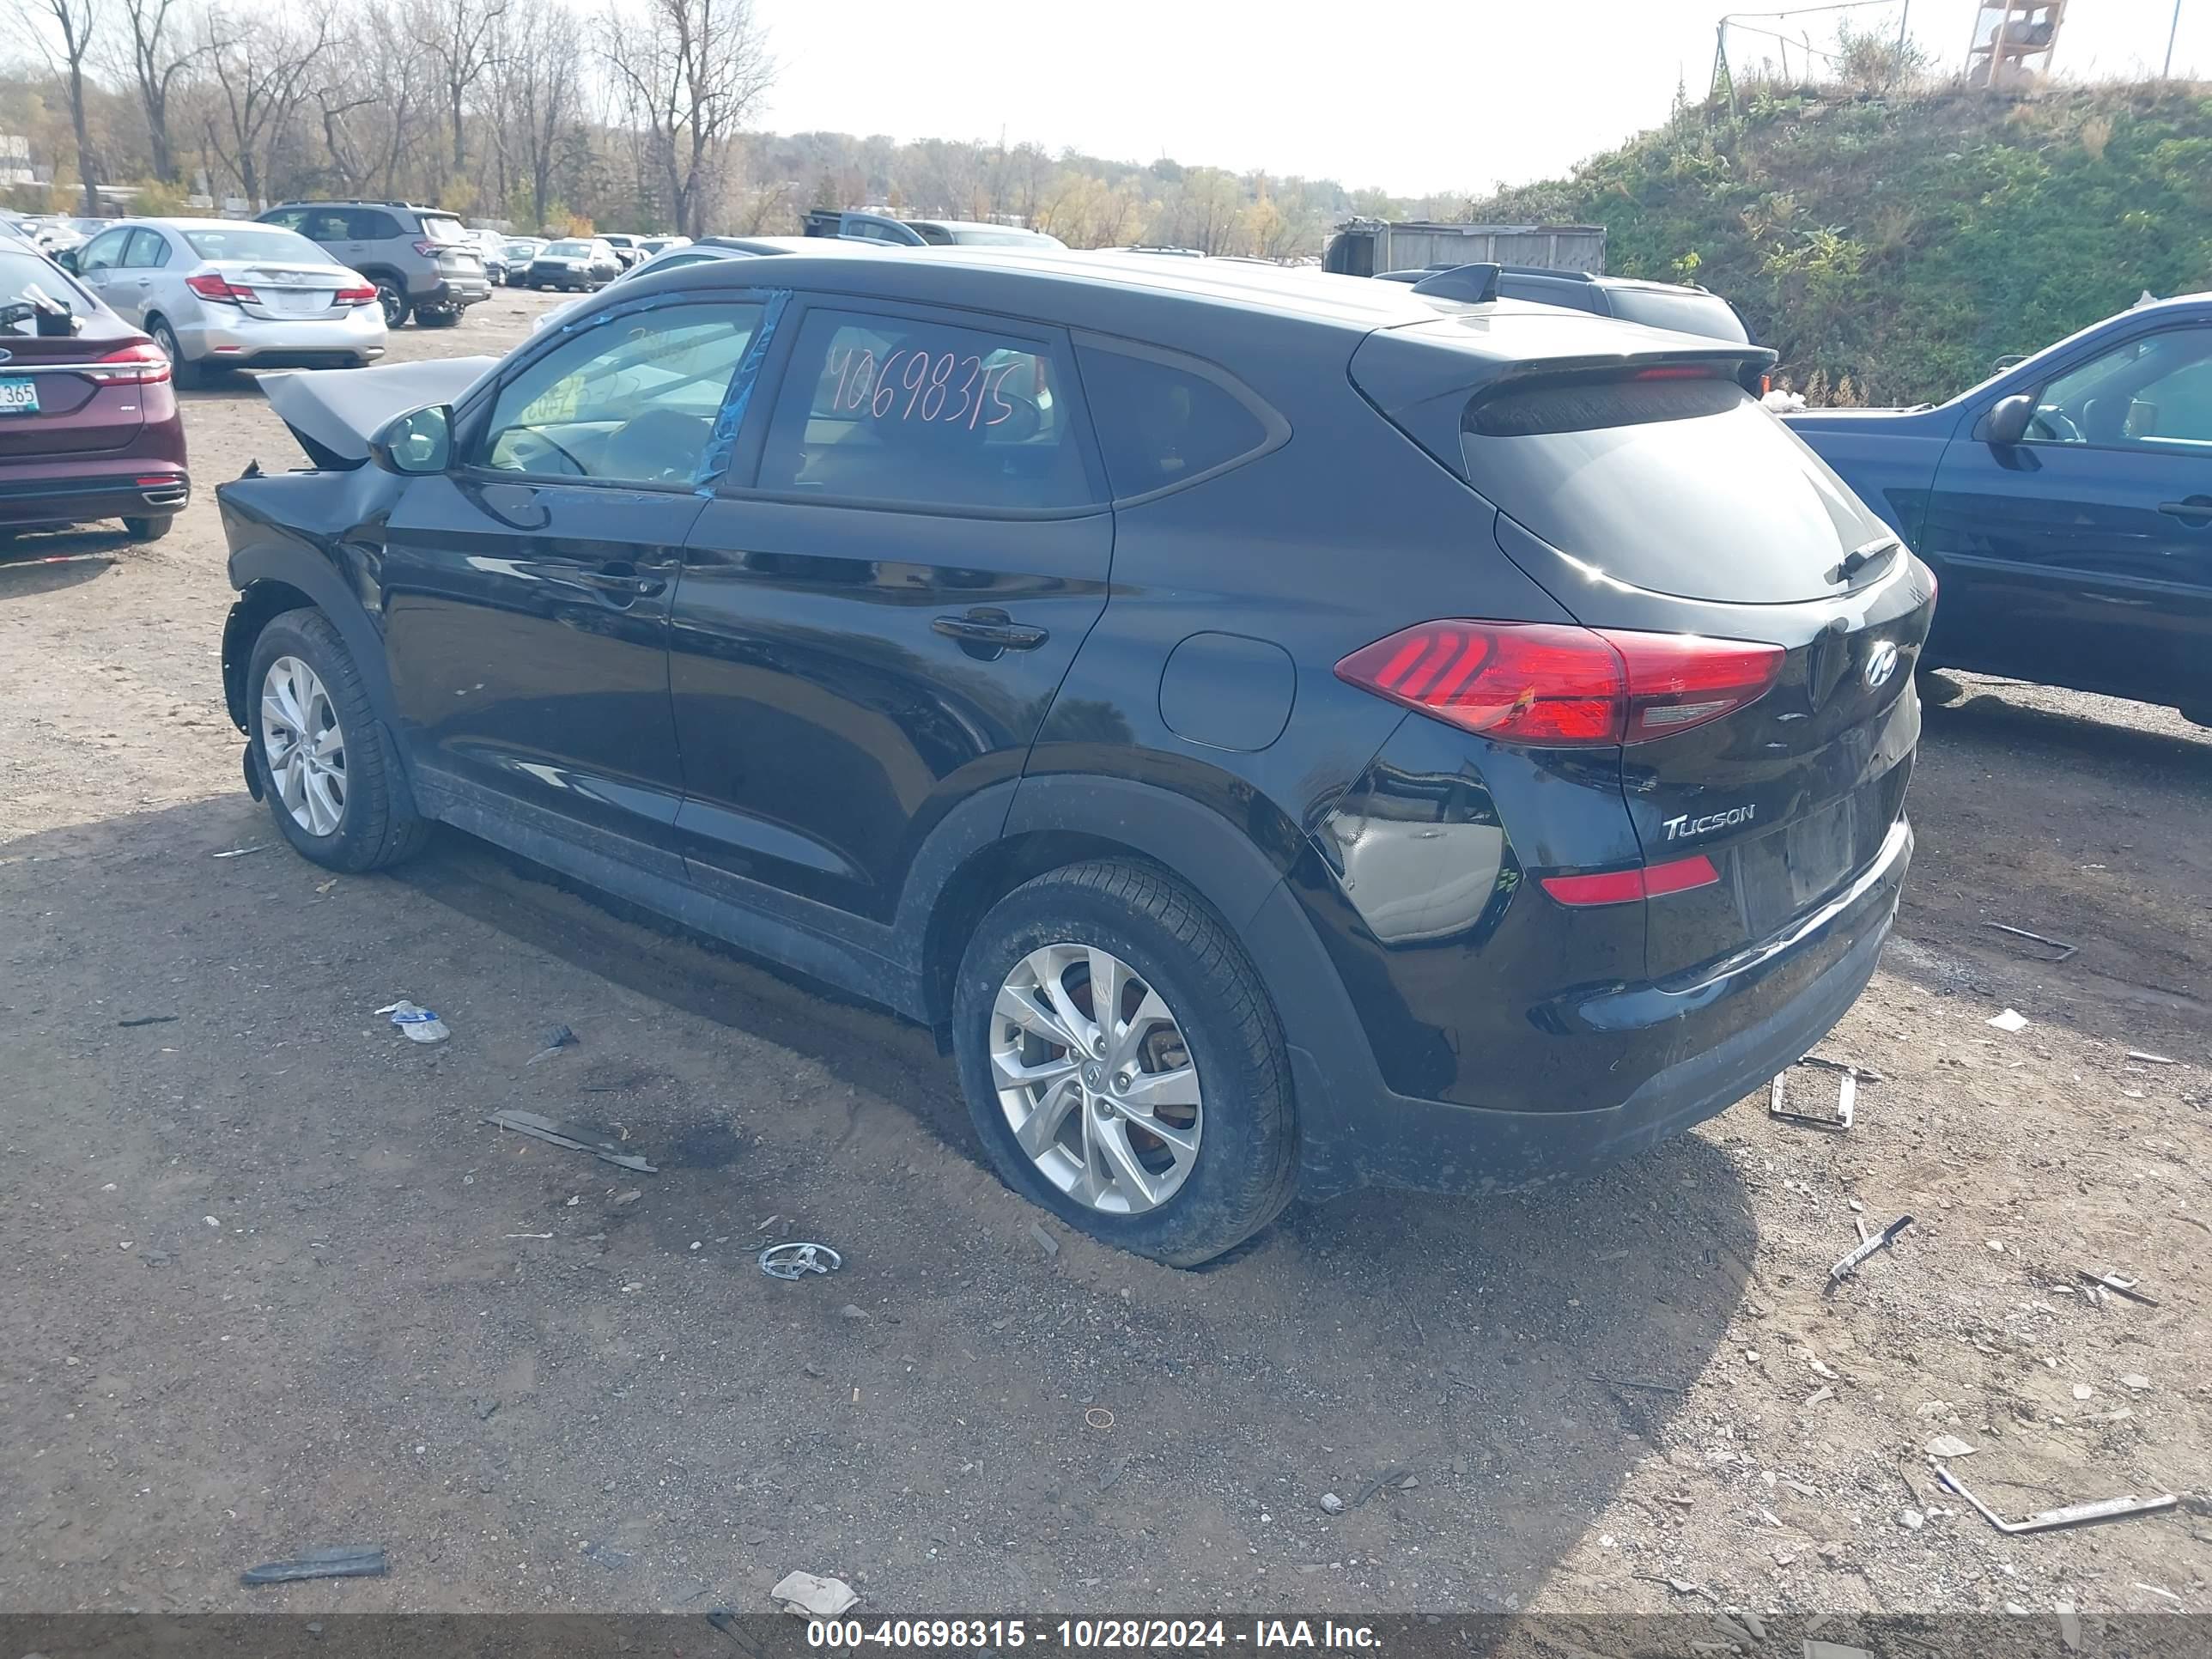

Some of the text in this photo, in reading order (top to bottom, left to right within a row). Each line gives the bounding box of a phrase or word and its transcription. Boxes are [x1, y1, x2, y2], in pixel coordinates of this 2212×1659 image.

[4, 385, 34, 403] 365
[830, 348, 1026, 430] 40698315
[1662, 805, 1756, 841] TUCSON
